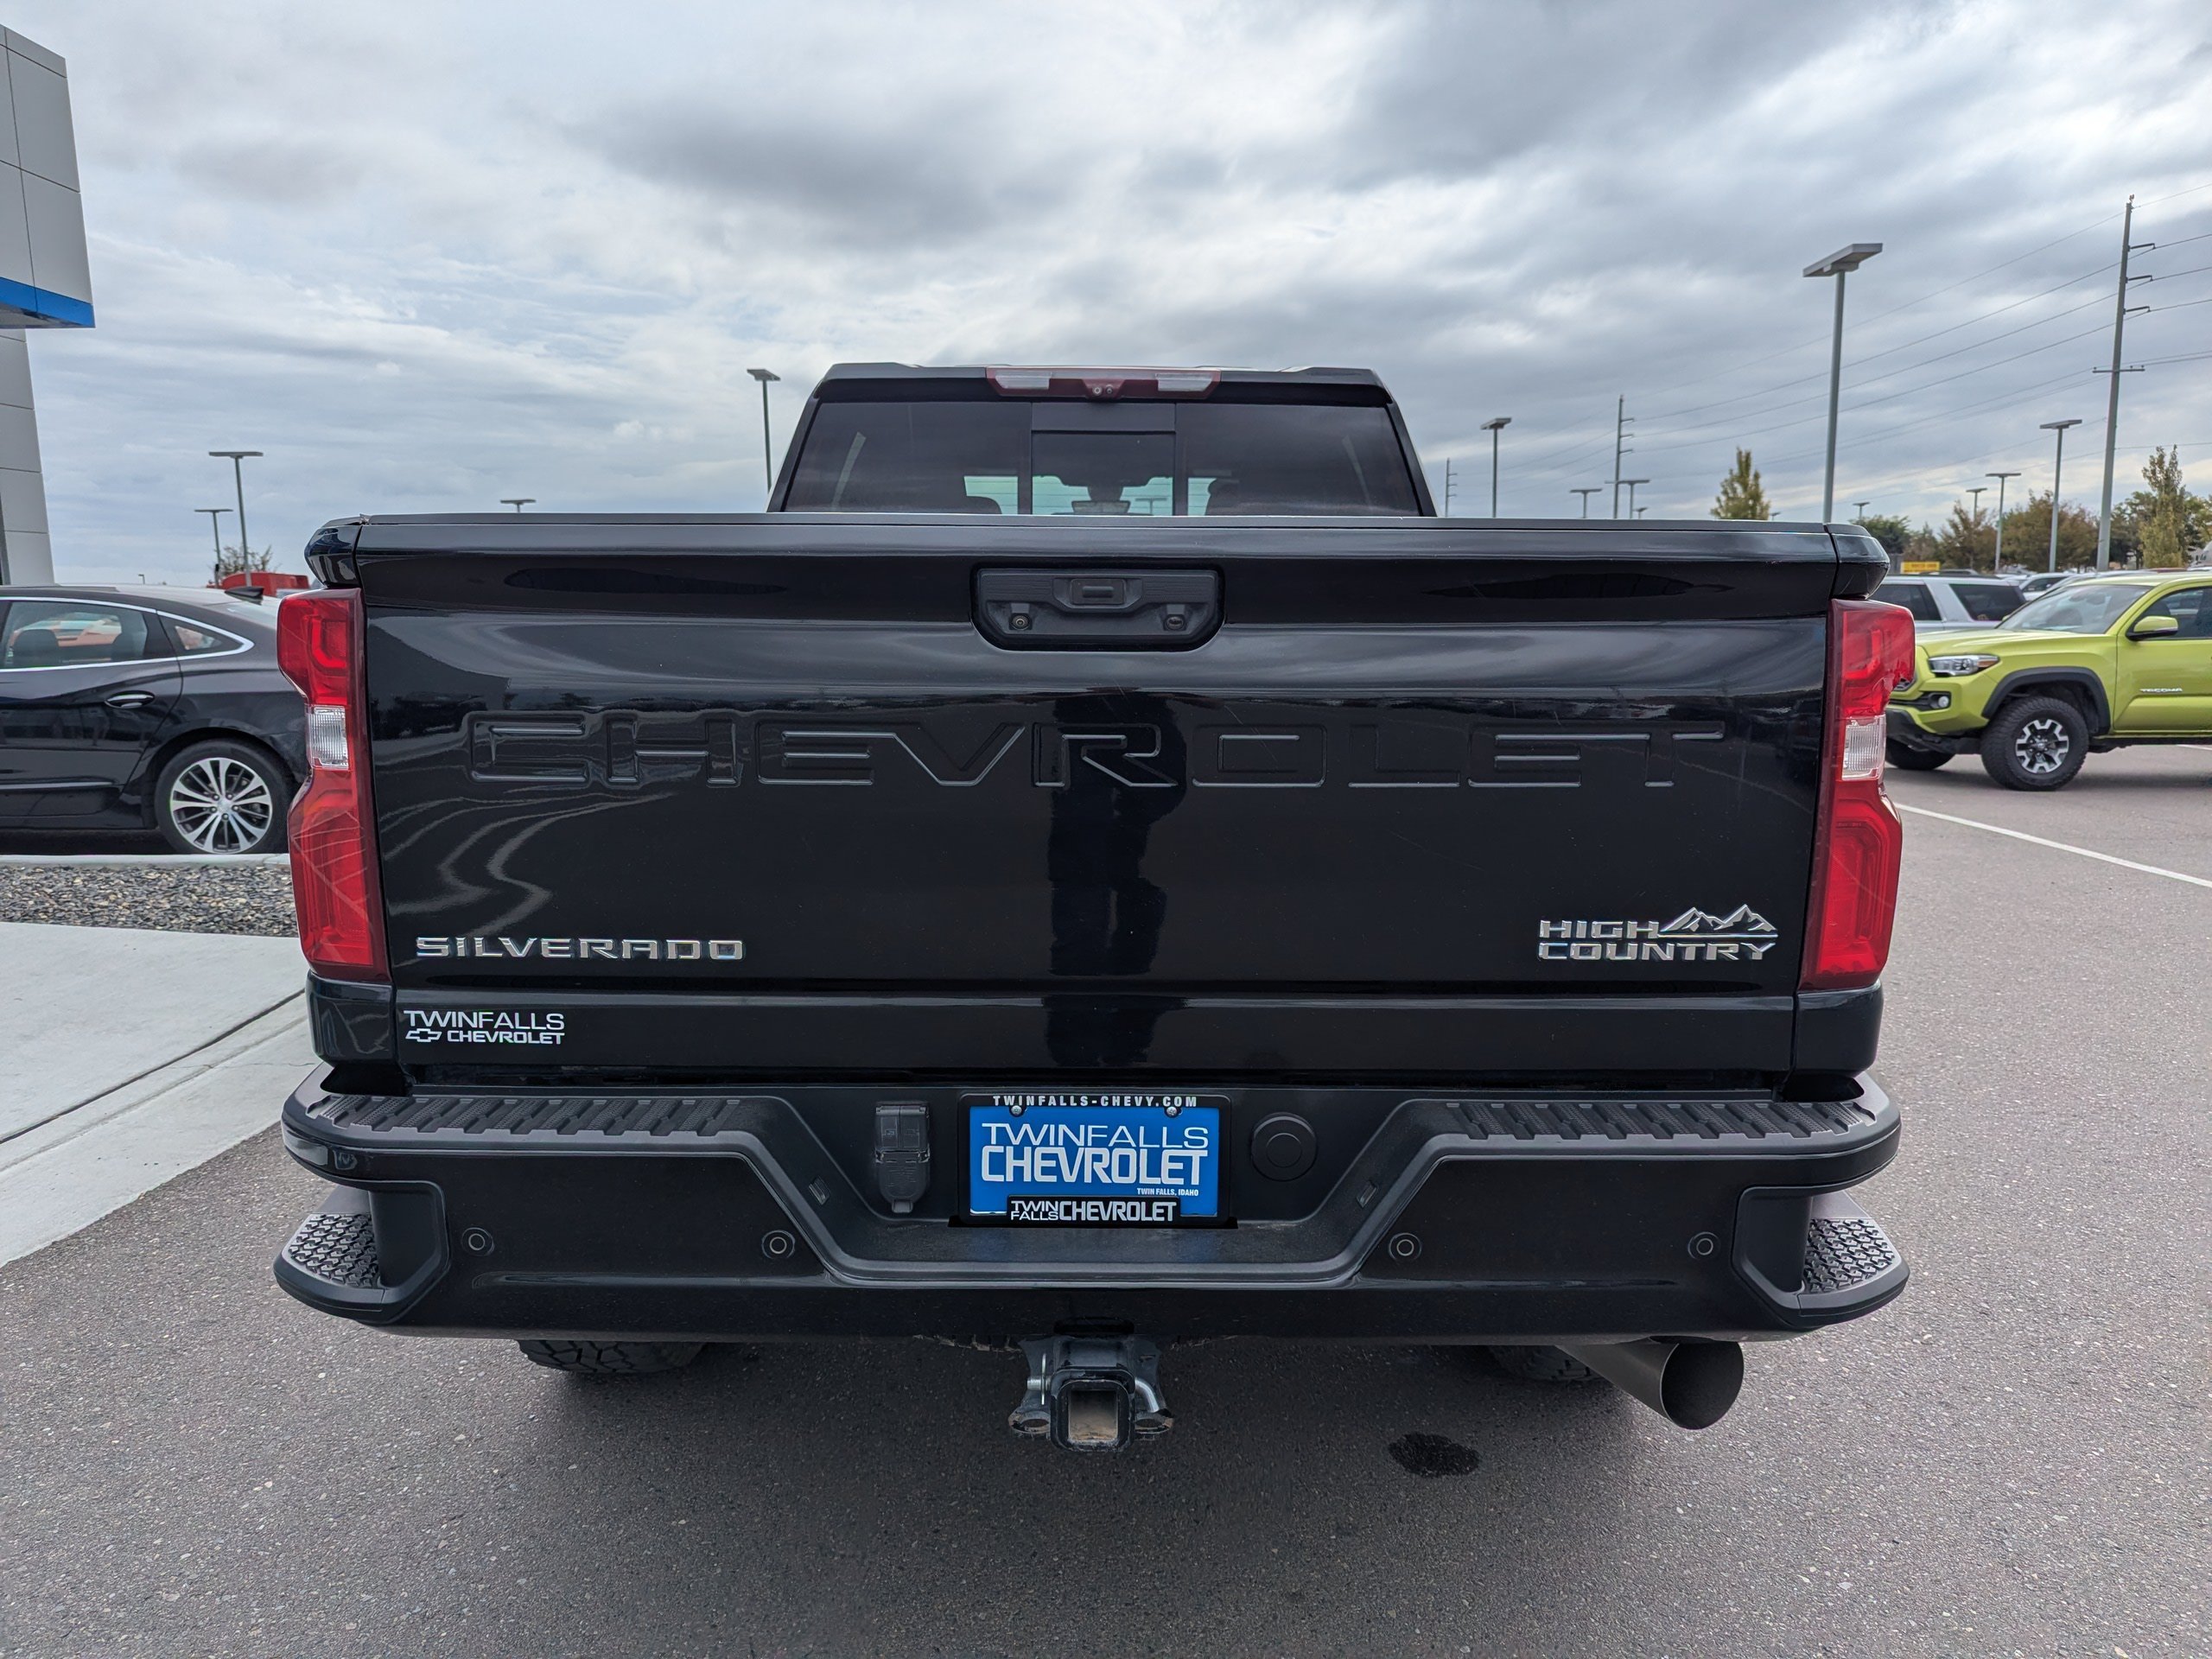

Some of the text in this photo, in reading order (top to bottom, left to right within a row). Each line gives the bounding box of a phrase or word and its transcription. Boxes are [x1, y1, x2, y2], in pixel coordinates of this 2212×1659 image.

[468, 717, 1726, 790] CHEVROLET
[1539, 919, 1660, 939] HIGH
[415, 936, 745, 961] SILVERADO
[1538, 942, 1777, 962] COUNTRY
[447, 1030, 566, 1046] CHEVROLET
[992, 1094, 1198, 1108] TWINFALLS-CHEVY.COM
[981, 1145, 1209, 1185] CHEVROLET
[1136, 1187, 1199, 1197] TWIN FALLS, IDAHO
[1010, 1200, 1059, 1211] TWIN
[1058, 1200, 1177, 1222] CHEVROLET
[1010, 1211, 1059, 1221] FALLS
